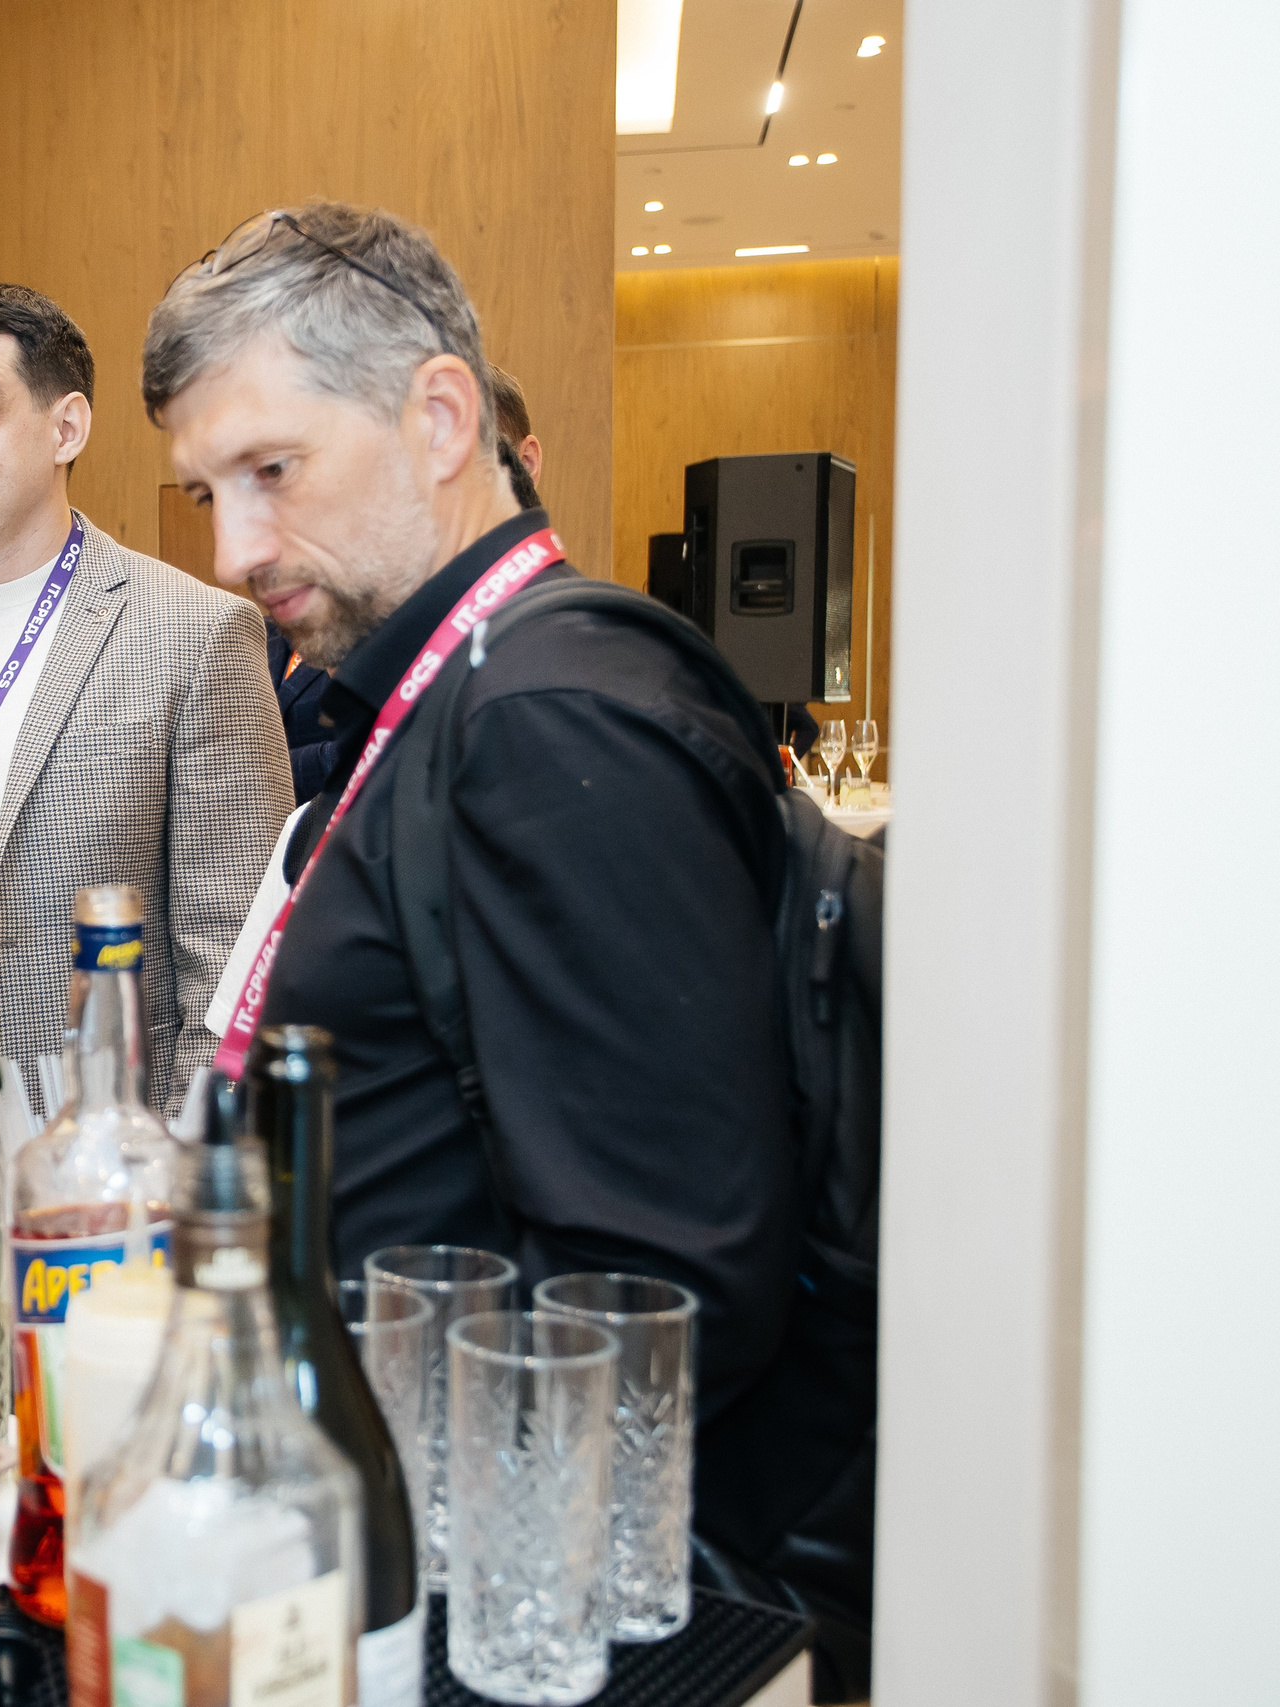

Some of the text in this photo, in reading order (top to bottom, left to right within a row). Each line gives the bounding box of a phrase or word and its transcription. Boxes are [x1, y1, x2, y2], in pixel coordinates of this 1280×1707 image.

[61, 543, 80, 571] OCS
[22, 582, 61, 645] IT-СРЕДА
[399, 650, 444, 701] OCS
[451, 542, 550, 634] IT-СРЕДА
[0, 660, 19, 689] OCS
